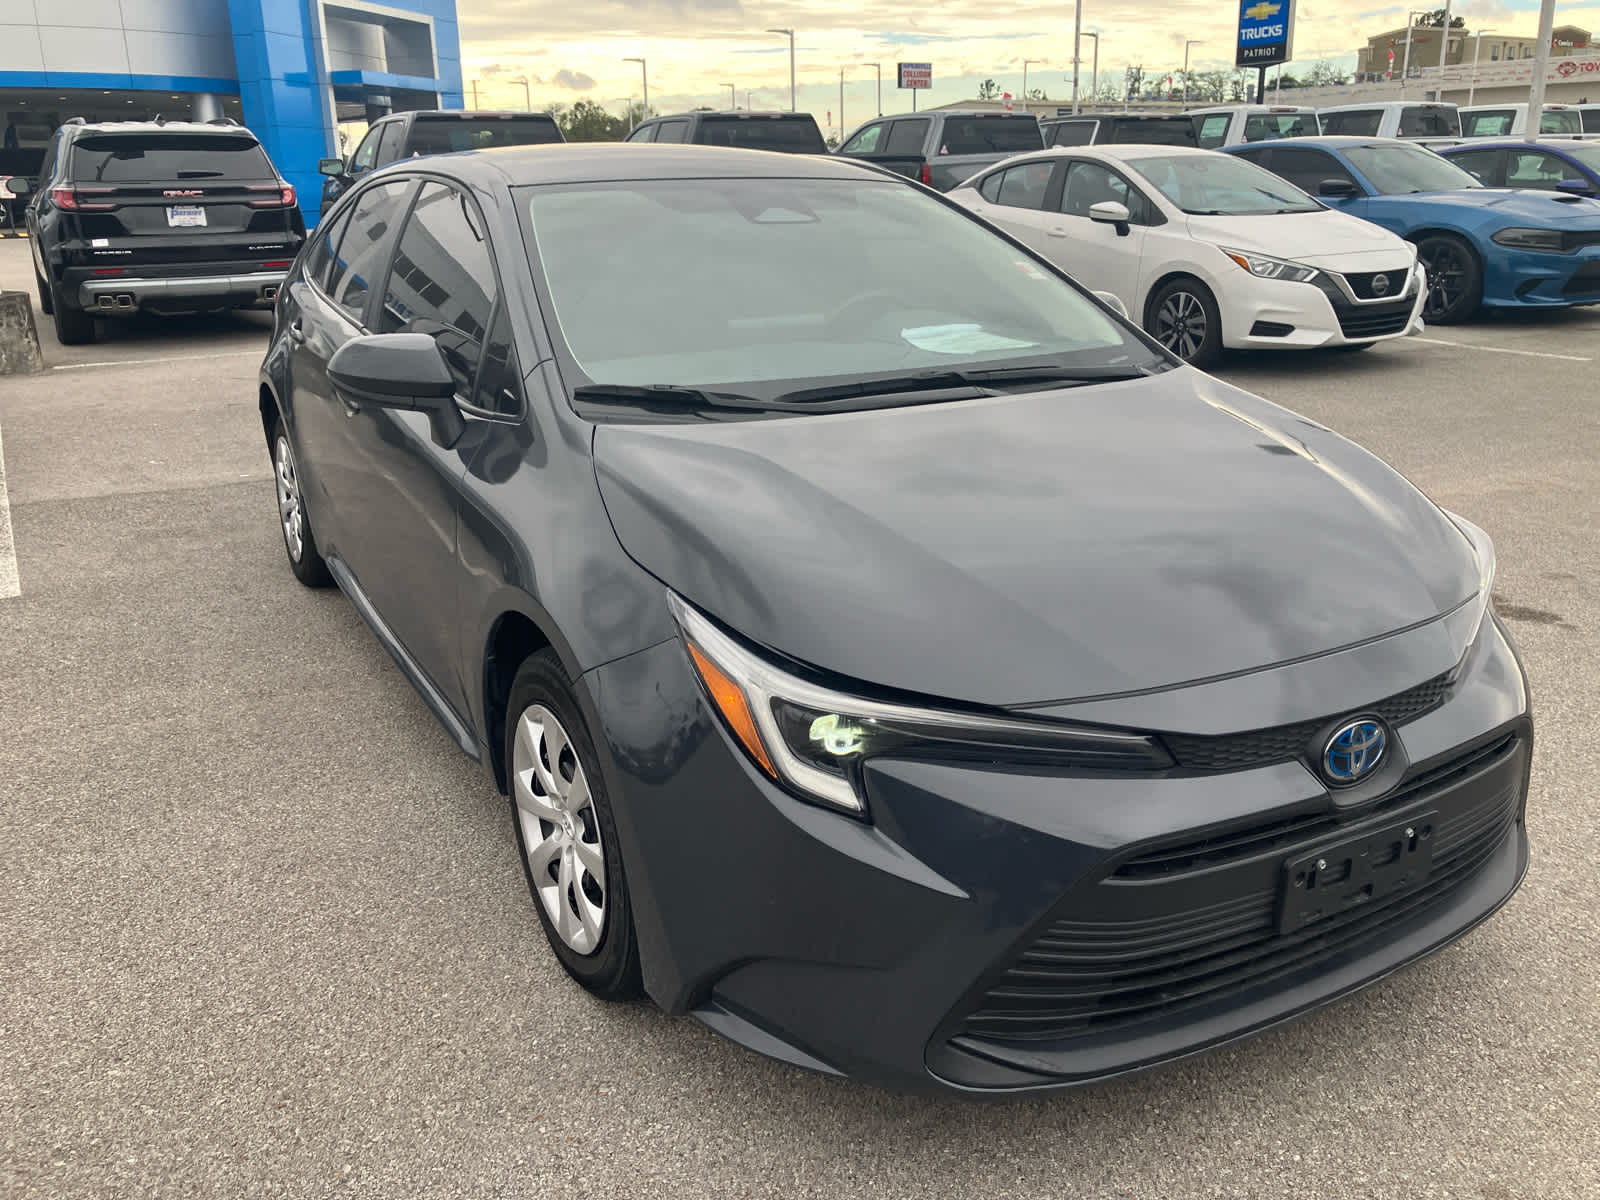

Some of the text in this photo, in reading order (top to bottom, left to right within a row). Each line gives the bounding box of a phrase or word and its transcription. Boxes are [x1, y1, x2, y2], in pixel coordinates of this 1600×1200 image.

[1240, 24, 1283, 40] TRUCKS
[1244, 48, 1275, 57] PATRIOT
[163, 190, 203, 199] GMC
